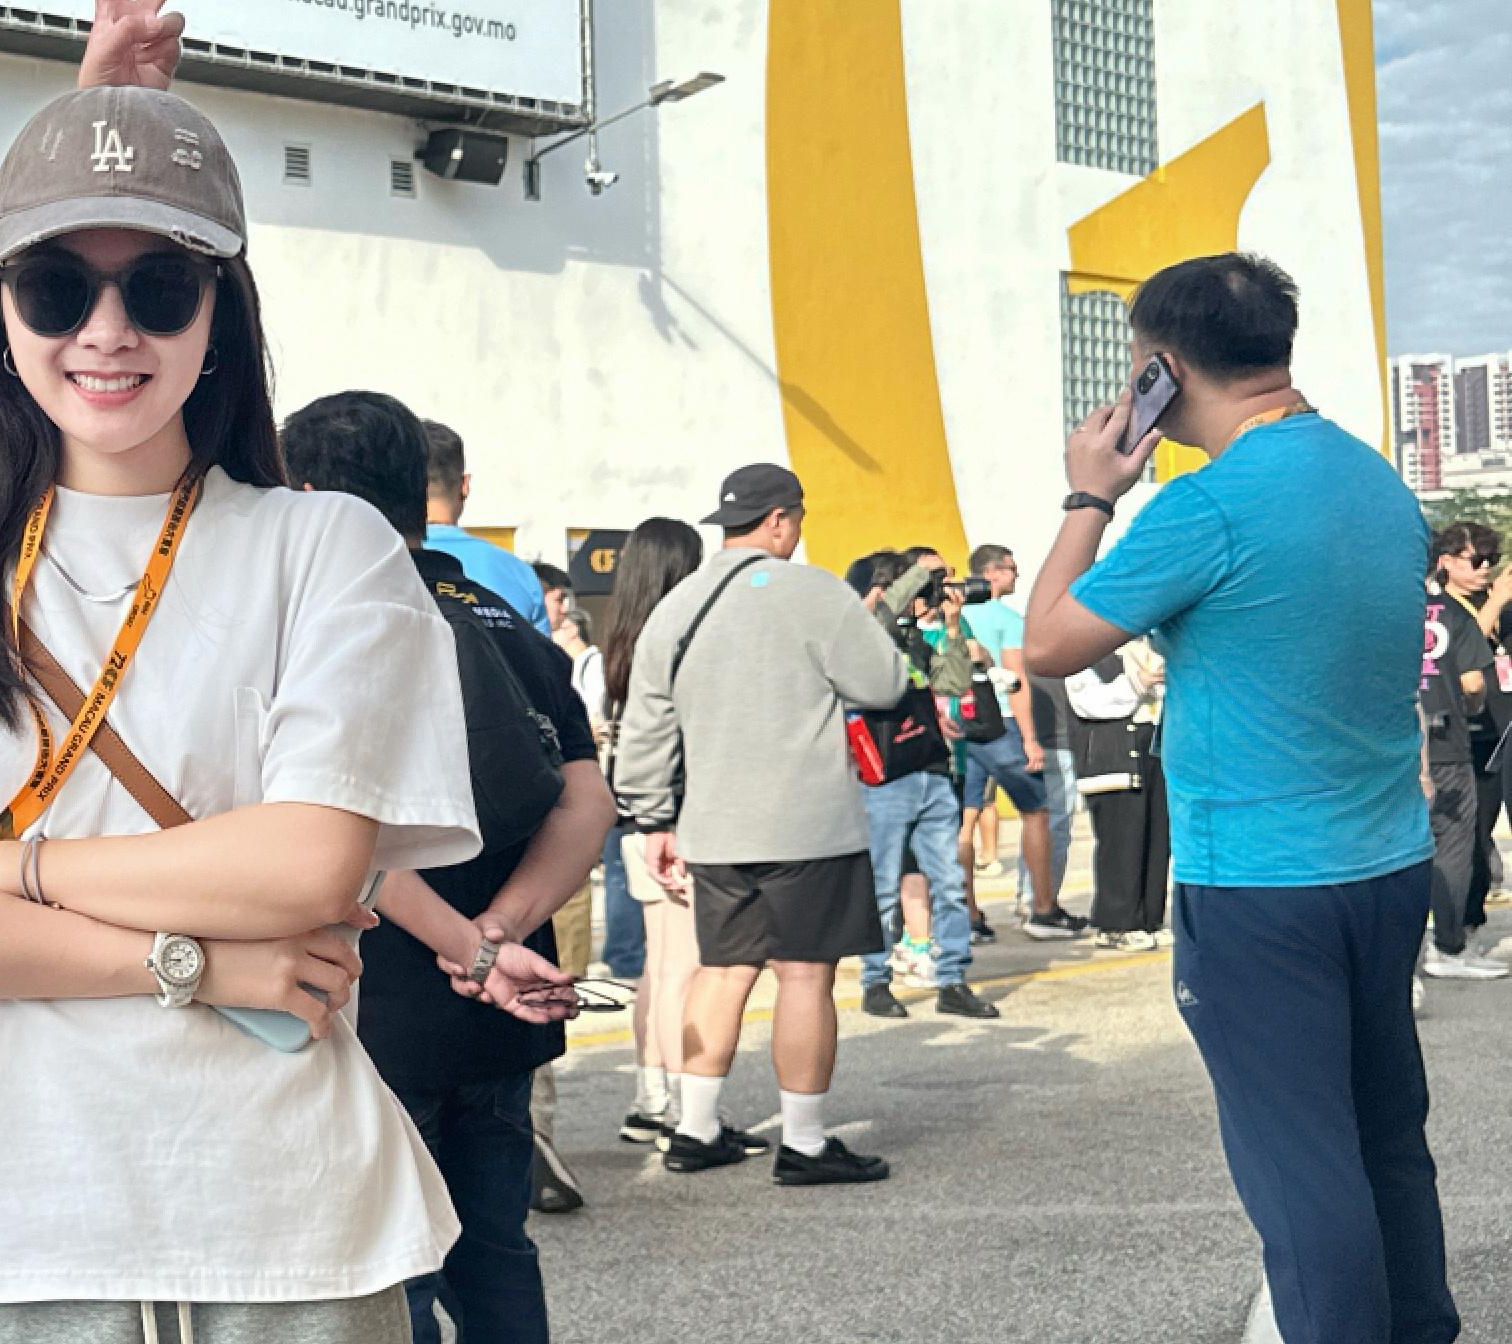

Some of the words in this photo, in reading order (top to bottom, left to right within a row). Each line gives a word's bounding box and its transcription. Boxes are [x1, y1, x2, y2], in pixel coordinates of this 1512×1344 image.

[91, 120, 134, 172] LA
[78, 692, 106, 734] MACAU
[55, 734, 84, 775] GRAND
[37, 775, 59, 802] PRIX
